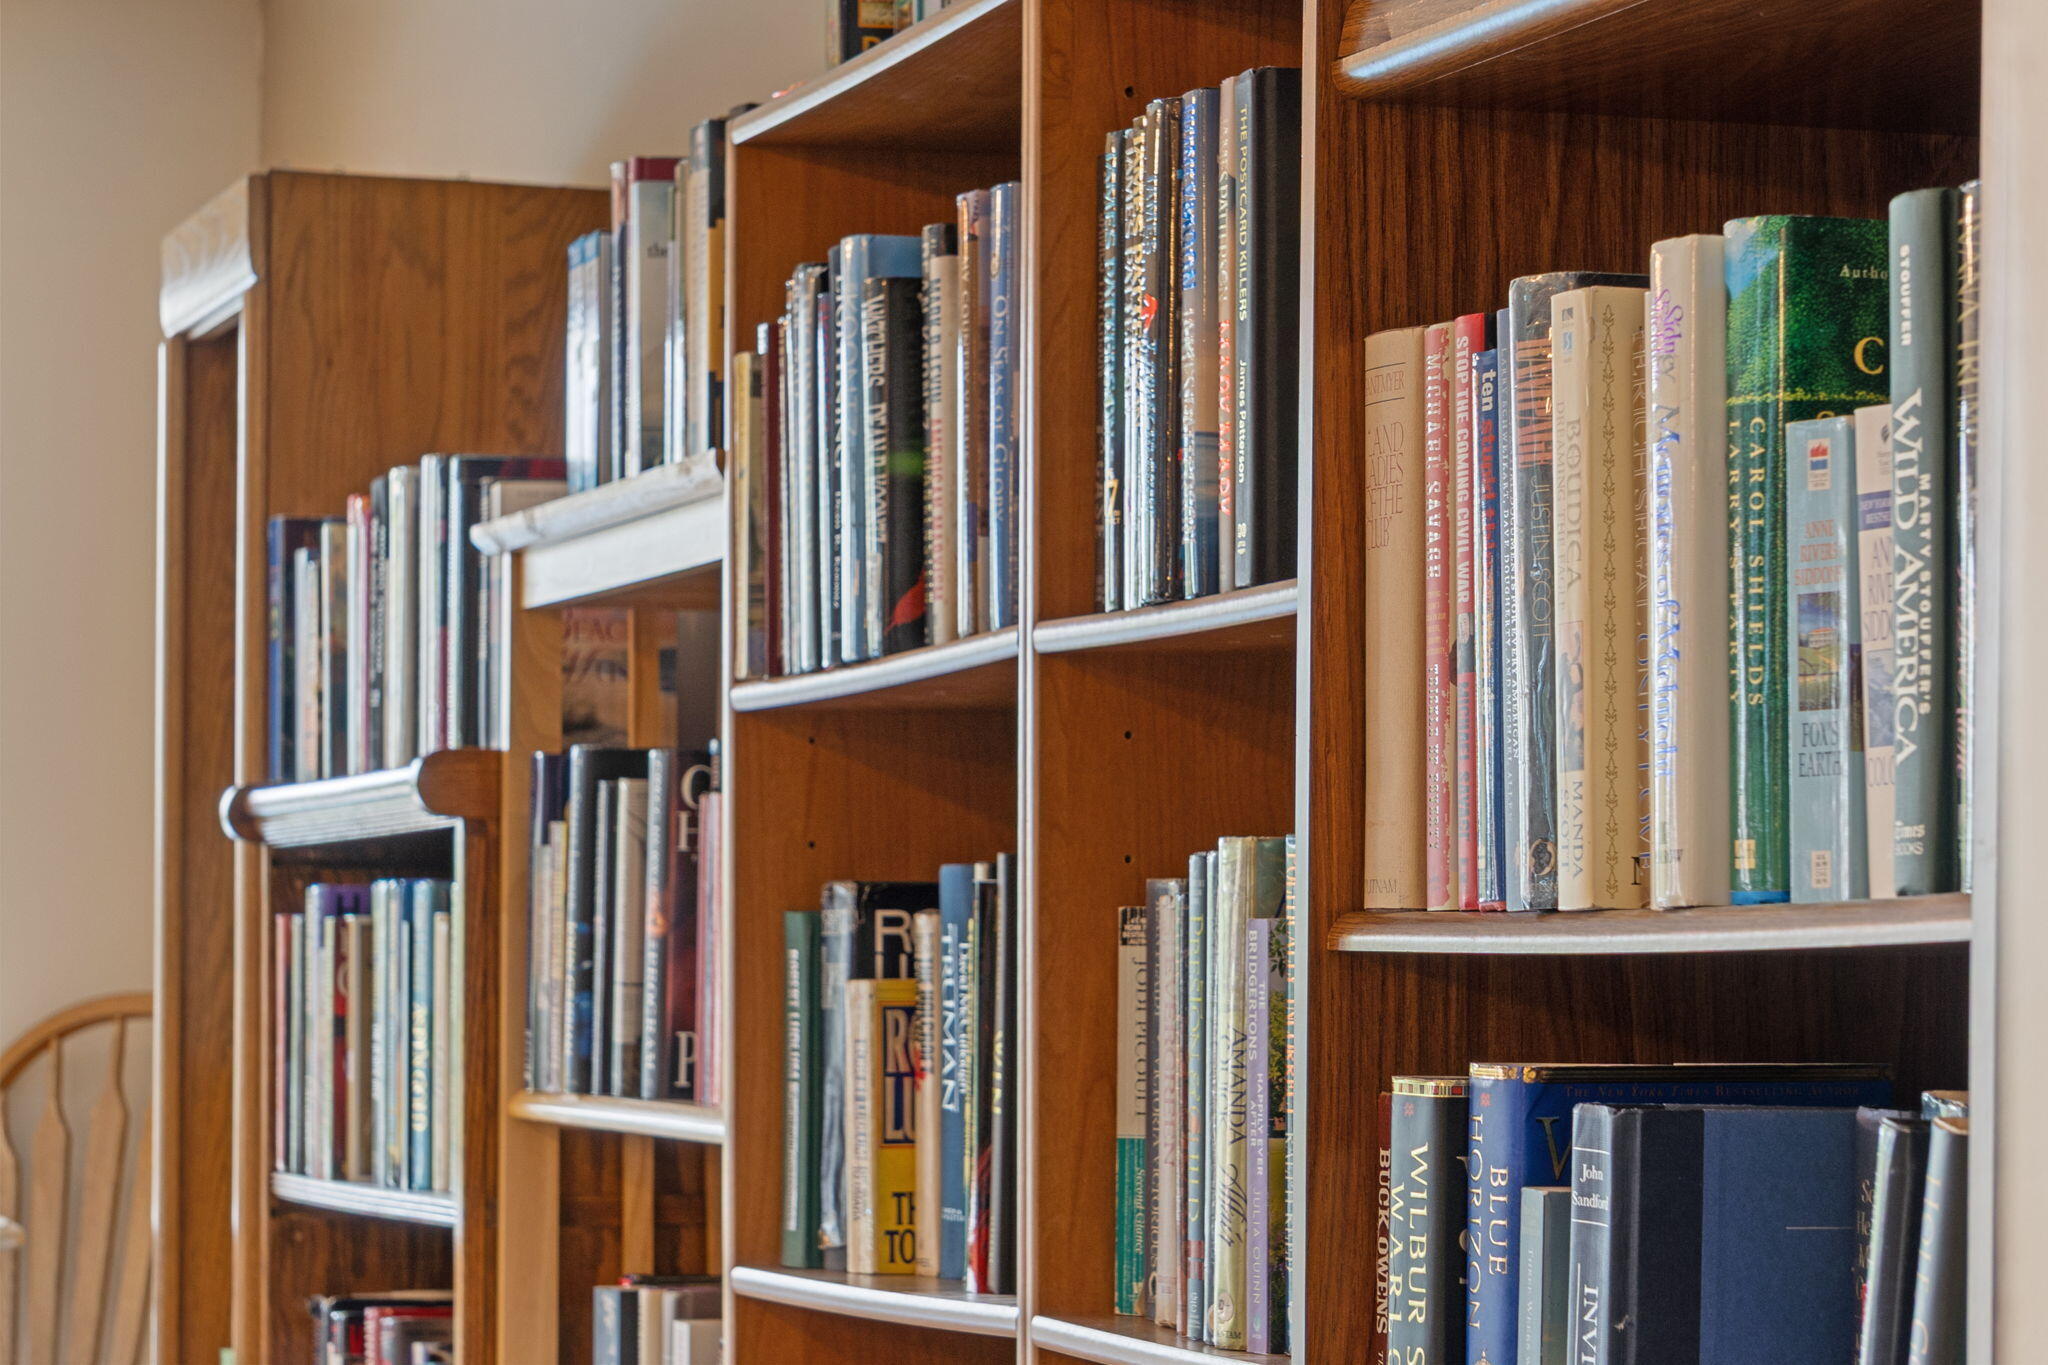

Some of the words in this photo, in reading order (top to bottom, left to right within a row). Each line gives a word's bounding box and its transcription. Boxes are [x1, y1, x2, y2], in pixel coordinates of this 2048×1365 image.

[1239, 105, 1248, 142] THE
[1239, 145, 1248, 245] POSTCARD
[1239, 250, 1248, 321] KILLERS
[1839, 264, 1889, 281] Autho
[1898, 243, 1913, 347] STOUFFER
[1238, 359, 1247, 407] James
[1456, 335, 1469, 384] STOP
[1480, 368, 1497, 412] ten
[1456, 387, 1469, 422] THE
[1238, 410, 1247, 484] Patterson
[1456, 428, 1470, 503] COMING
[1749, 415, 1767, 535] CAROL
[1892, 387, 1923, 531] WILD
[1426, 480, 1442, 578] SAVAGE
[1457, 507, 1470, 558] CIVIL
[1530, 475, 1551, 559] JUSTIN
[1564, 417, 1583, 588] BOUDICA
[1804, 519, 1835, 539] ANNE
[1918, 472, 1932, 559] MARTY
[1457, 559, 1471, 604] WAR
[1747, 553, 1766, 706] SHIELDS
[1892, 542, 1926, 765] AMERICA
[1917, 569, 1932, 715] STOUFFER'S
[1560, 787, 1573, 873] SCOTT
[1573, 780, 1585, 879] MANDA
[941, 922, 958, 1113] TRUMAN
[1248, 929, 1259, 1061] BRIDGERTONS
[1257, 982, 1266, 1010] THE
[1230, 1027, 1248, 1145] AMANDA
[1250, 1099, 1259, 1147] AFTER
[1256, 1072, 1266, 1134] HAPPILY
[1134, 1166, 1147, 1210] Second
[1255, 1139, 1265, 1176] EVER
[1377, 1147, 1391, 1234] BUCK
[1579, 1163, 1605, 1184] John
[1134, 1212, 1147, 1255] Glance
[1251, 1186, 1263, 1238] JULIA
[1407, 1141, 1430, 1325] WILBUR
[1466, 1112, 1484, 1330] HORIZON
[1488, 1164, 1509, 1276] BLUE
[1571, 1188, 1610, 1212] Sandford
[1250, 1245, 1263, 1304] QUINN
[1375, 1237, 1389, 1335] OWENS
